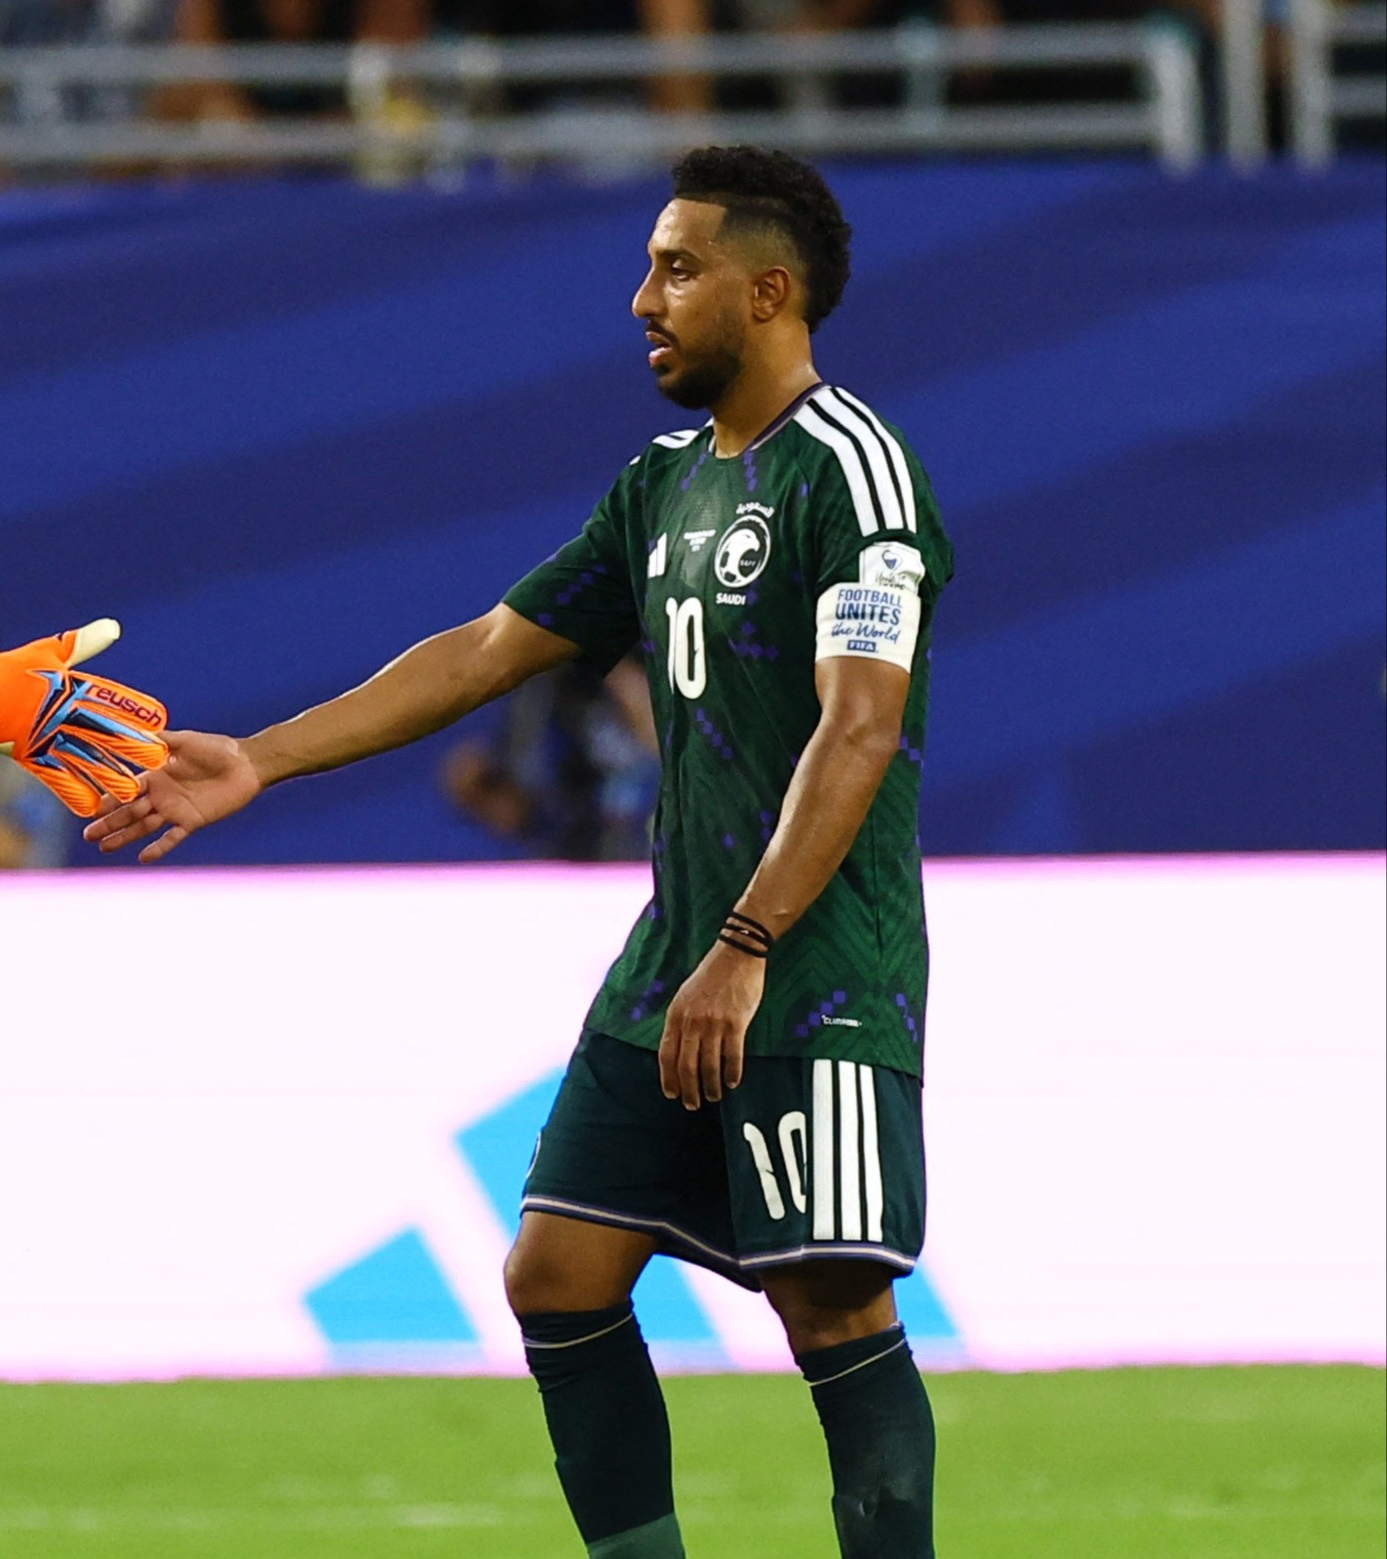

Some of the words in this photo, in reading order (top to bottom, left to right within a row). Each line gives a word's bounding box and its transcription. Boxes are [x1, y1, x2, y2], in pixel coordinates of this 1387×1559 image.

[716, 592, 746, 605] SAUDI
[837, 589, 902, 608] FOOTBALL
[835, 602, 902, 626] UNITES
[831, 621, 855, 637] the
[856, 622, 902, 644] World
[666, 597, 707, 700] 10
[848, 640, 875, 652] FIFA
[85, 684, 162, 727] reusch
